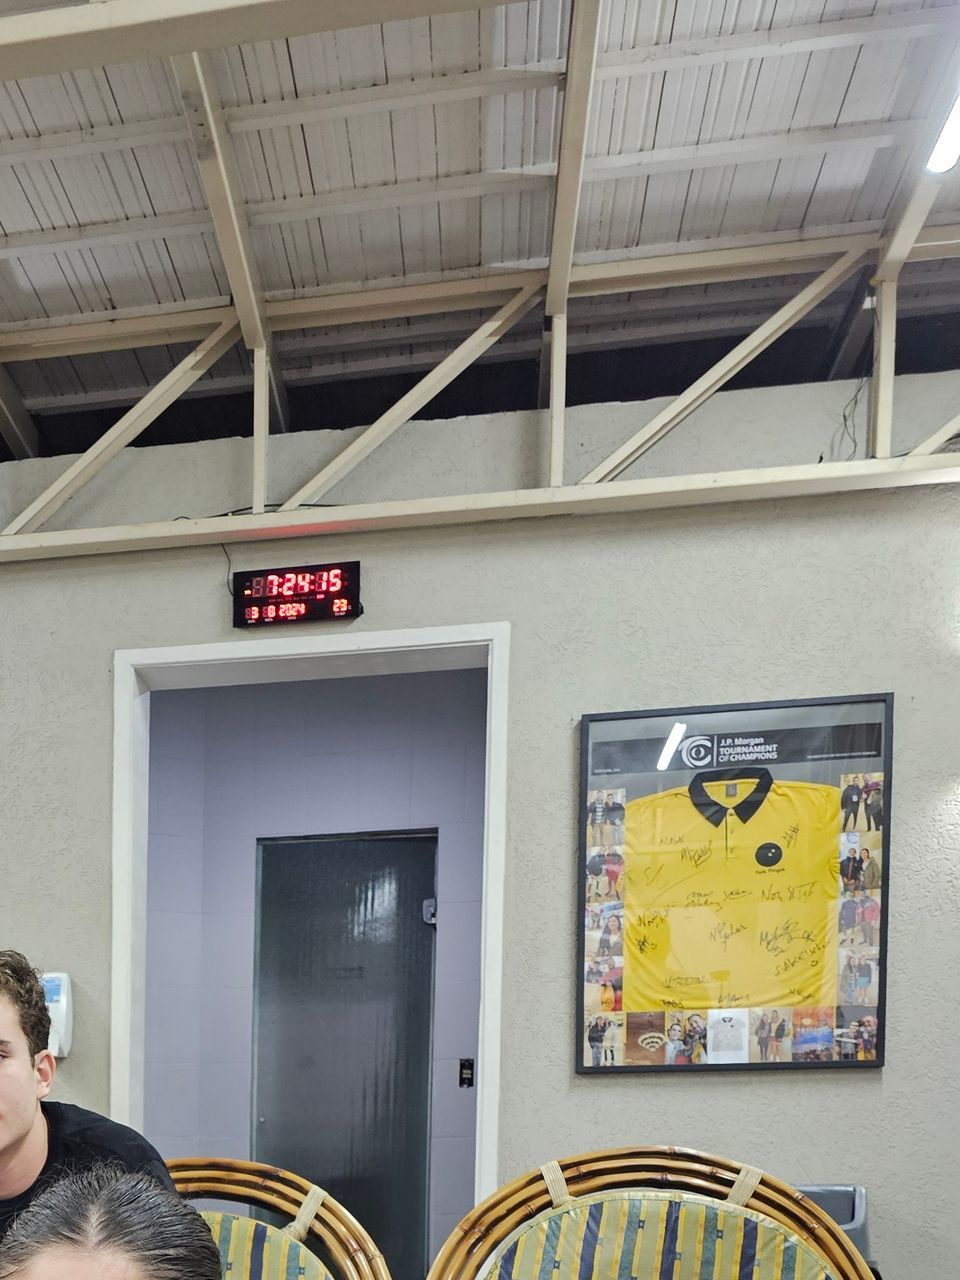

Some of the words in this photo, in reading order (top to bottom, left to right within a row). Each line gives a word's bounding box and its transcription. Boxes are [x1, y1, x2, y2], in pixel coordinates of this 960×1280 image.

[720, 738, 734, 746] J.P.
[734, 737, 764, 746] Morgan
[719, 744, 778, 755] TOURNAMENT
[718, 755, 730, 763] OF
[729, 751, 778, 762] CHAMPIONS
